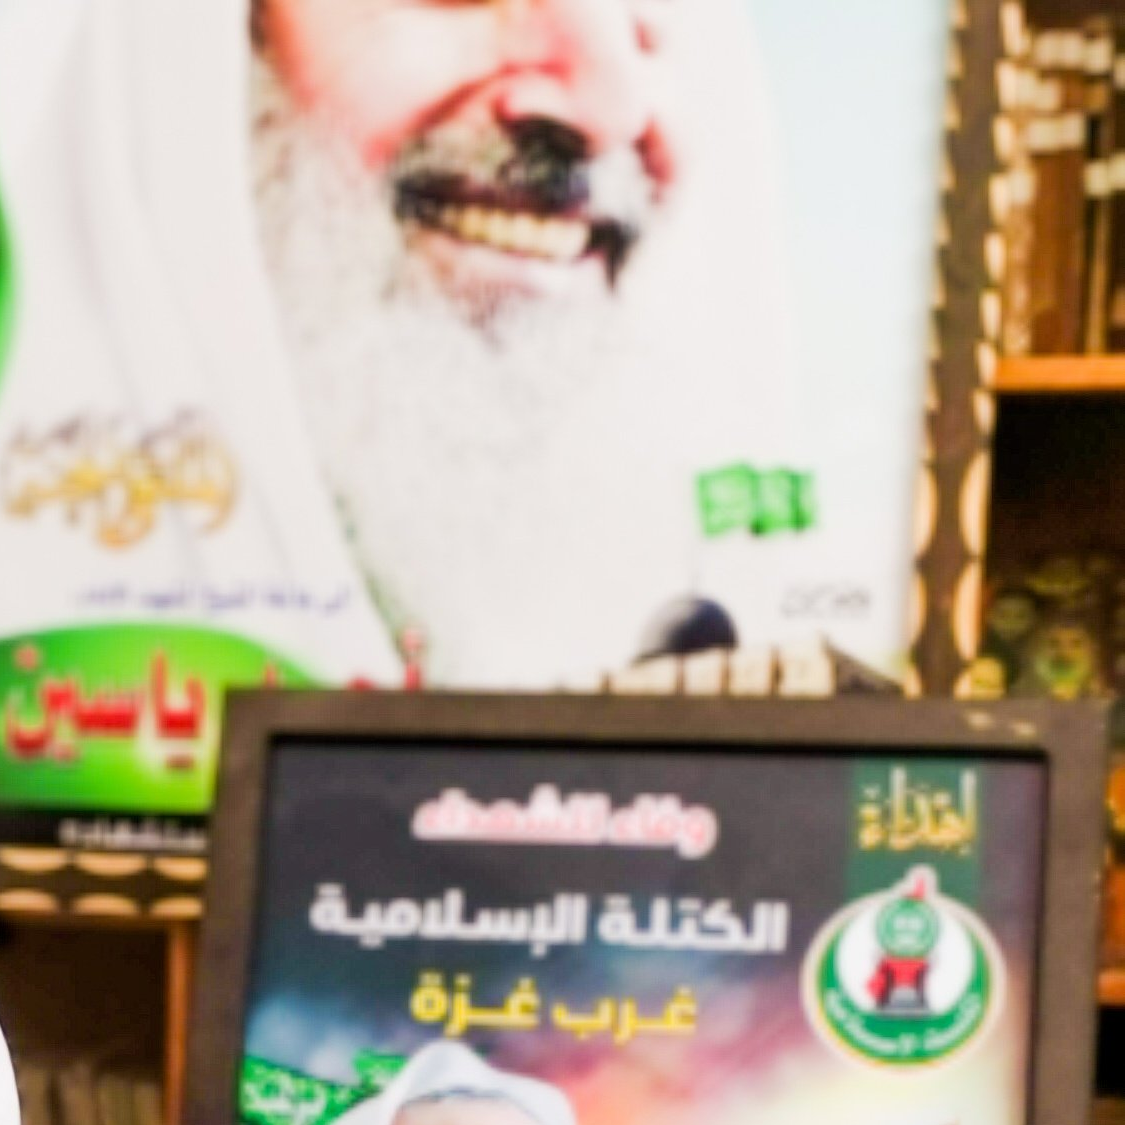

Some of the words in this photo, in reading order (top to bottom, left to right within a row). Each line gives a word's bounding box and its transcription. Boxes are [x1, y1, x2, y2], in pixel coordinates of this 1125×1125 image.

[6, 642, 205, 771] ياسين
[310, 882, 589, 958] الإسلامية
[598, 894, 790, 953] الكتلة
[410, 970, 540, 1039] غزة
[552, 985, 698, 1045] غرب
